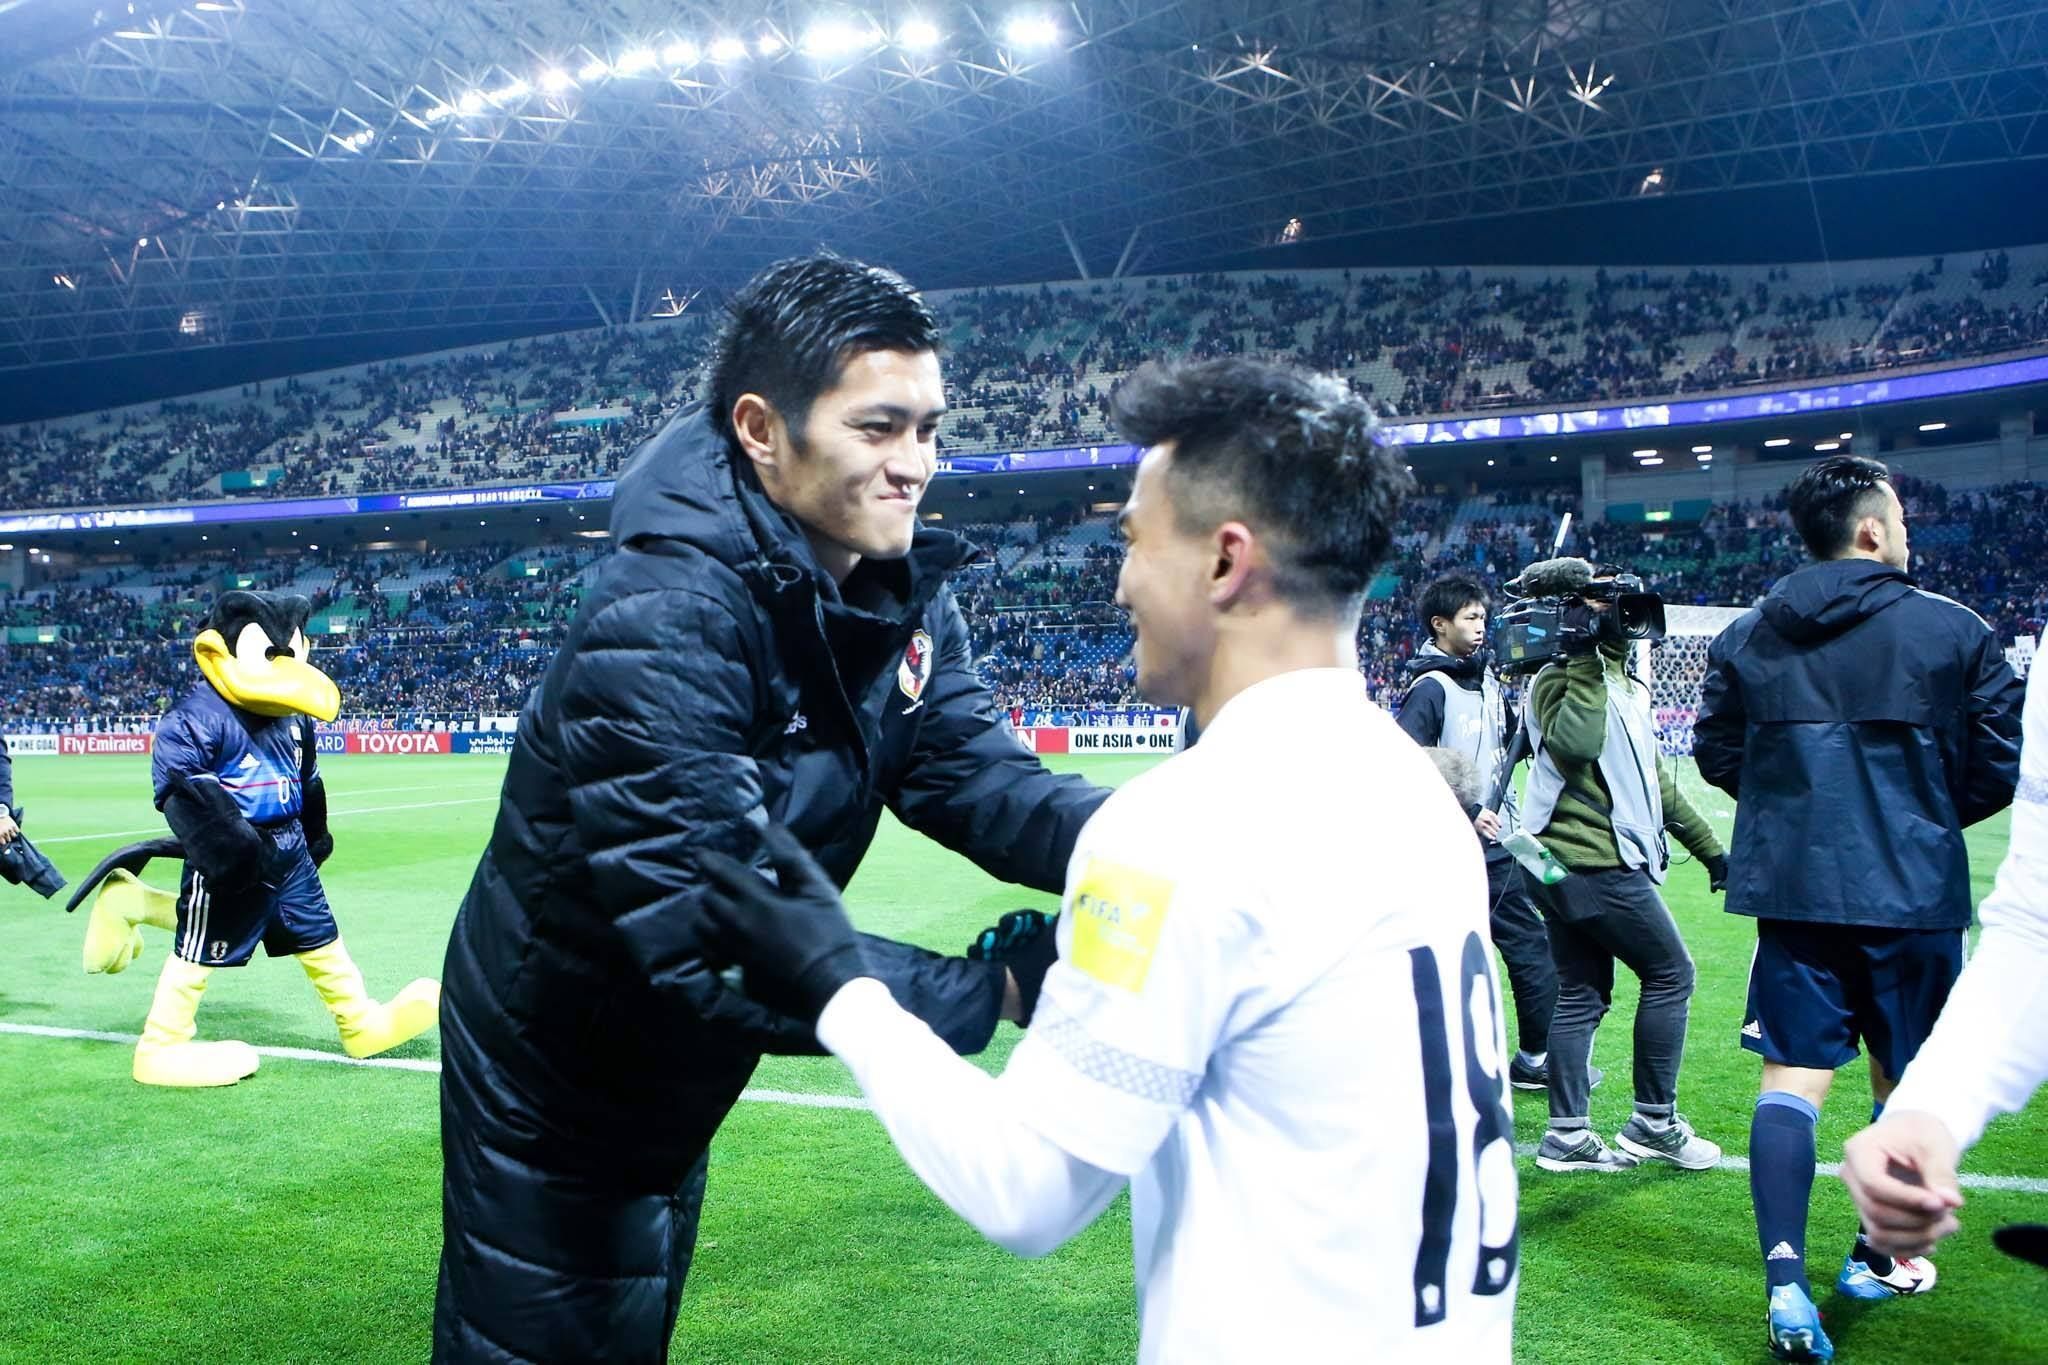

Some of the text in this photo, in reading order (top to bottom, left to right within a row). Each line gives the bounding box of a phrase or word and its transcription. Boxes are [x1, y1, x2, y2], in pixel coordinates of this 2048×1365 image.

[63, 736, 145, 754] Fly Emirates
[357, 733, 440, 753] TOYOTA
[1075, 734, 1174, 748] ONE ASIA ONE
[1407, 930, 1519, 1329] 18
